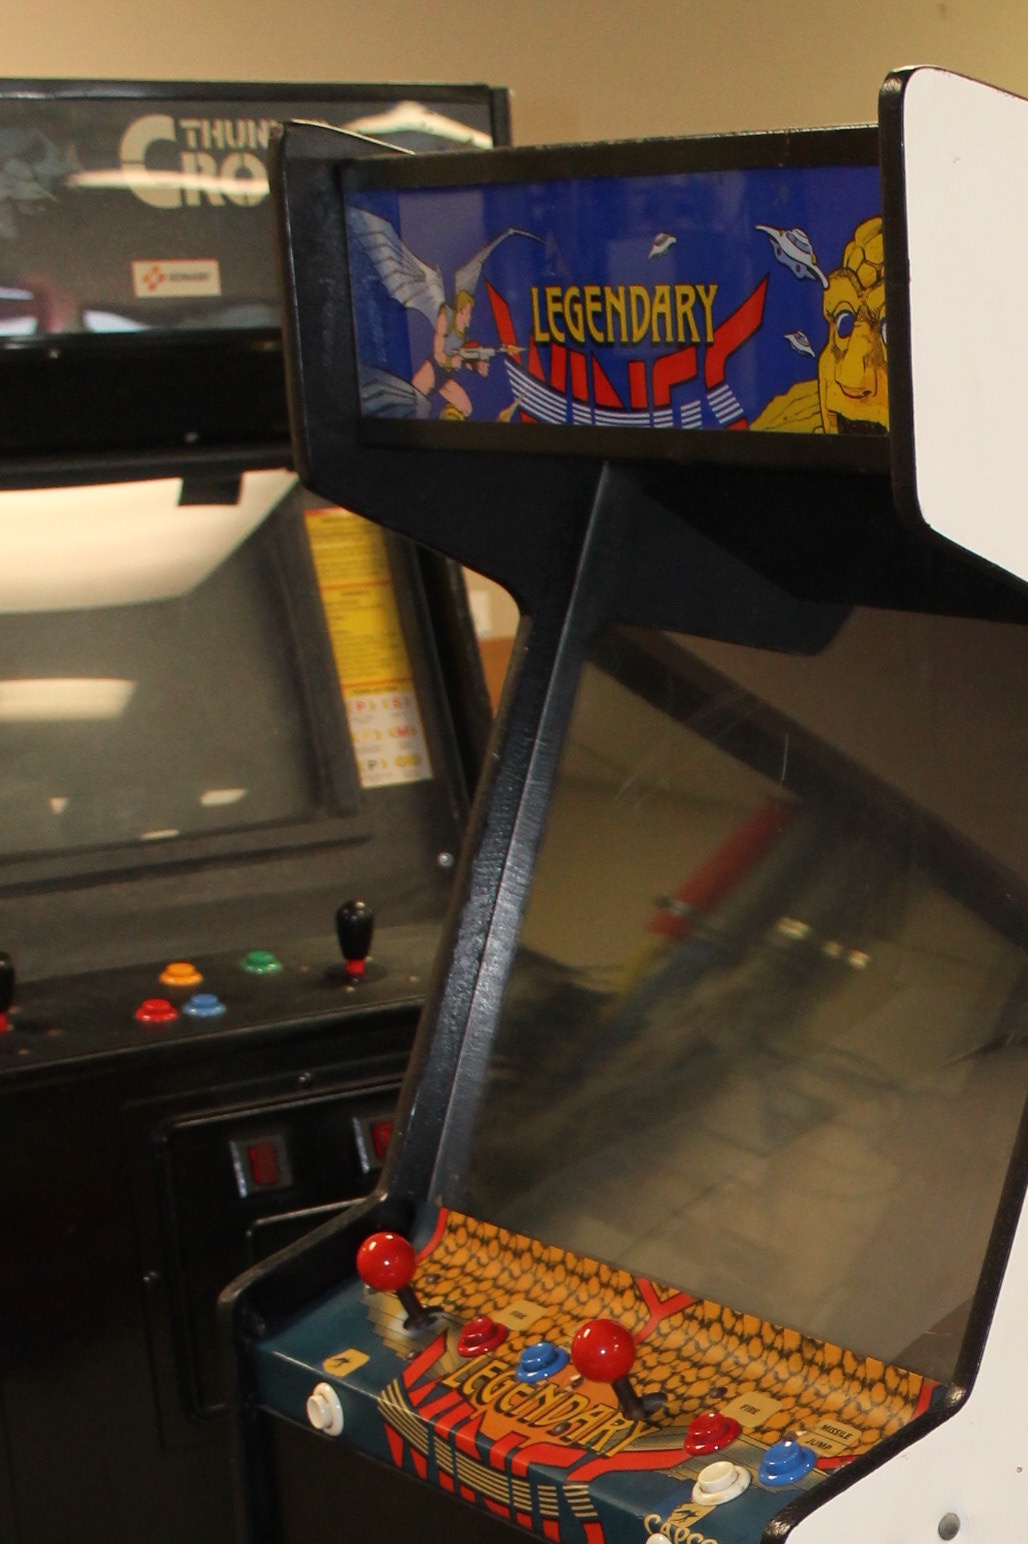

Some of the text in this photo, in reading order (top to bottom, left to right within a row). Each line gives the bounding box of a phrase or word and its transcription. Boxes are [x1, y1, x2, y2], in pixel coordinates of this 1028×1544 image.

[179, 117, 278, 150] THUN
[530, 282, 719, 345] LEGENDARY
[441, 1354, 662, 1459] LEGENDARY
[739, 1403, 761, 1416] FIRE
[804, 1438, 833, 1451] JUMP
[821, 1423, 854, 1441] MISSILE
